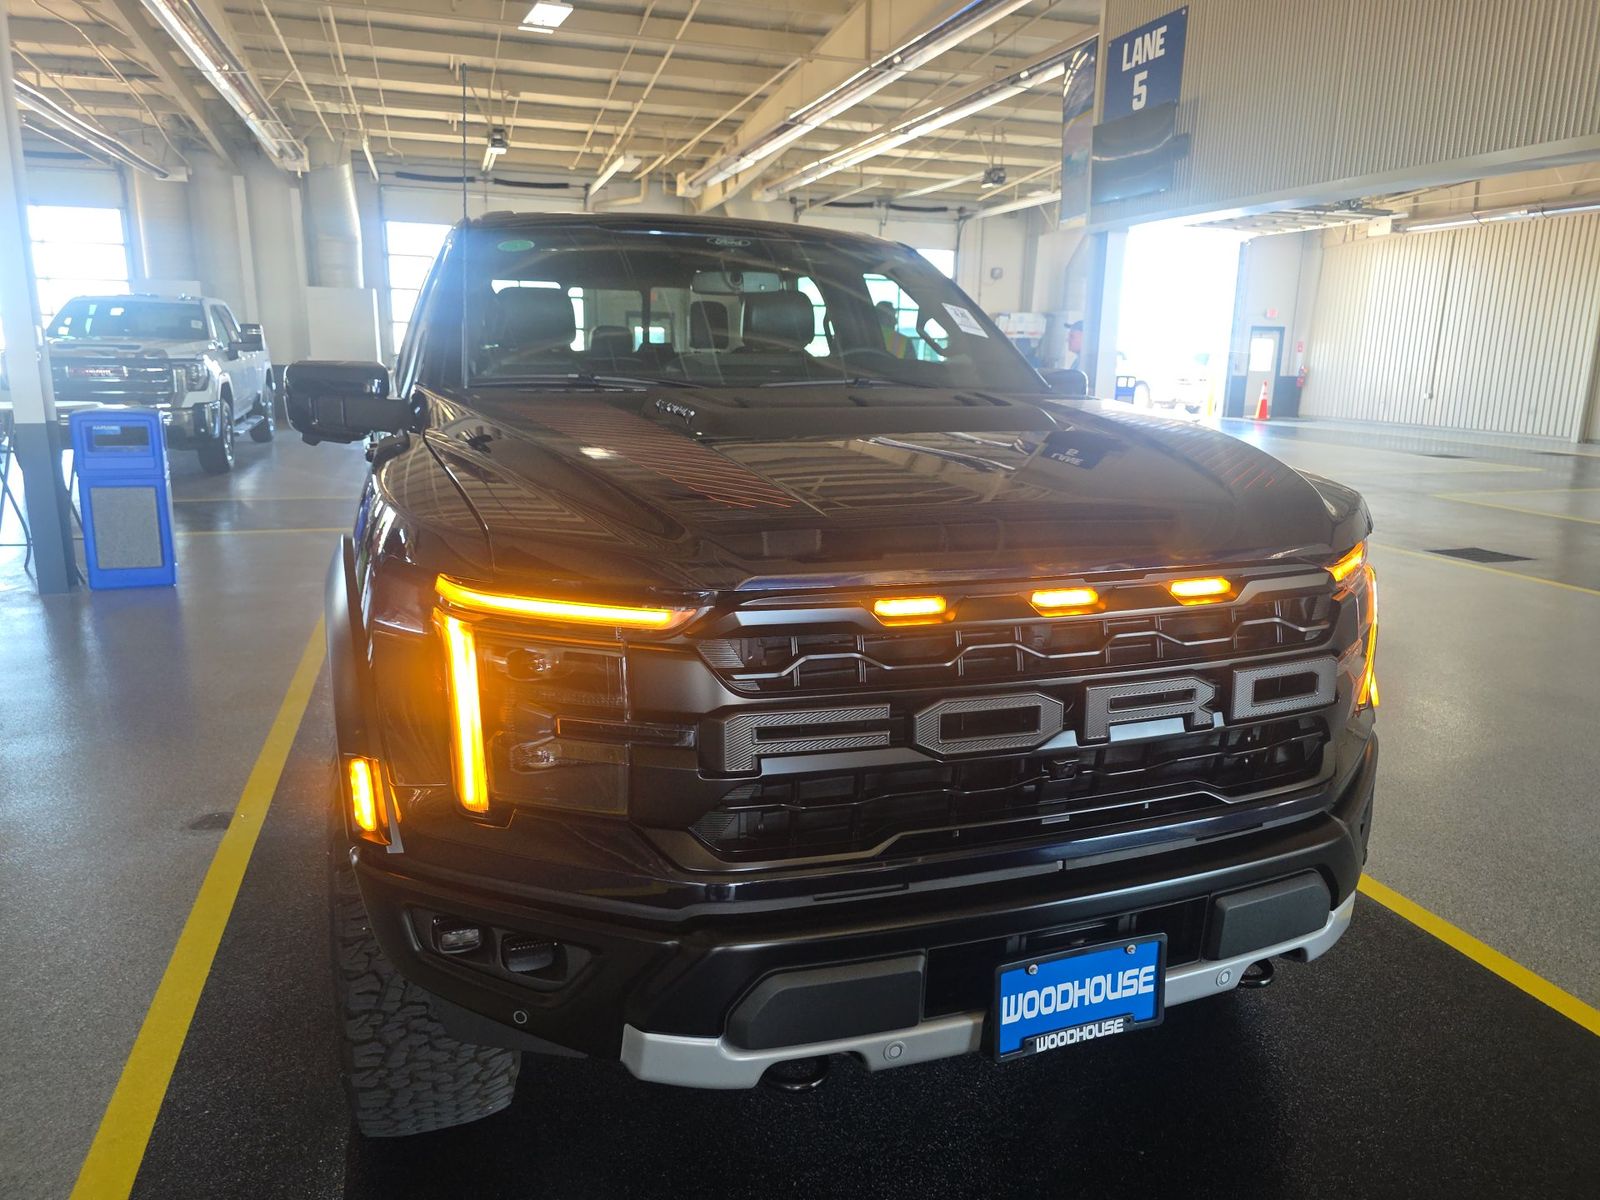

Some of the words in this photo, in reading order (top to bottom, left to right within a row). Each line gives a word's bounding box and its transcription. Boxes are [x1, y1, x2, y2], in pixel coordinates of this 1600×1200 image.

[1122, 25, 1167, 72] LANE
[1132, 70, 1148, 111] 5
[724, 654, 1338, 773] FORD
[1002, 965, 1155, 1025] WOODHOUSE
[1036, 1018, 1124, 1053] WOODHOUSE
